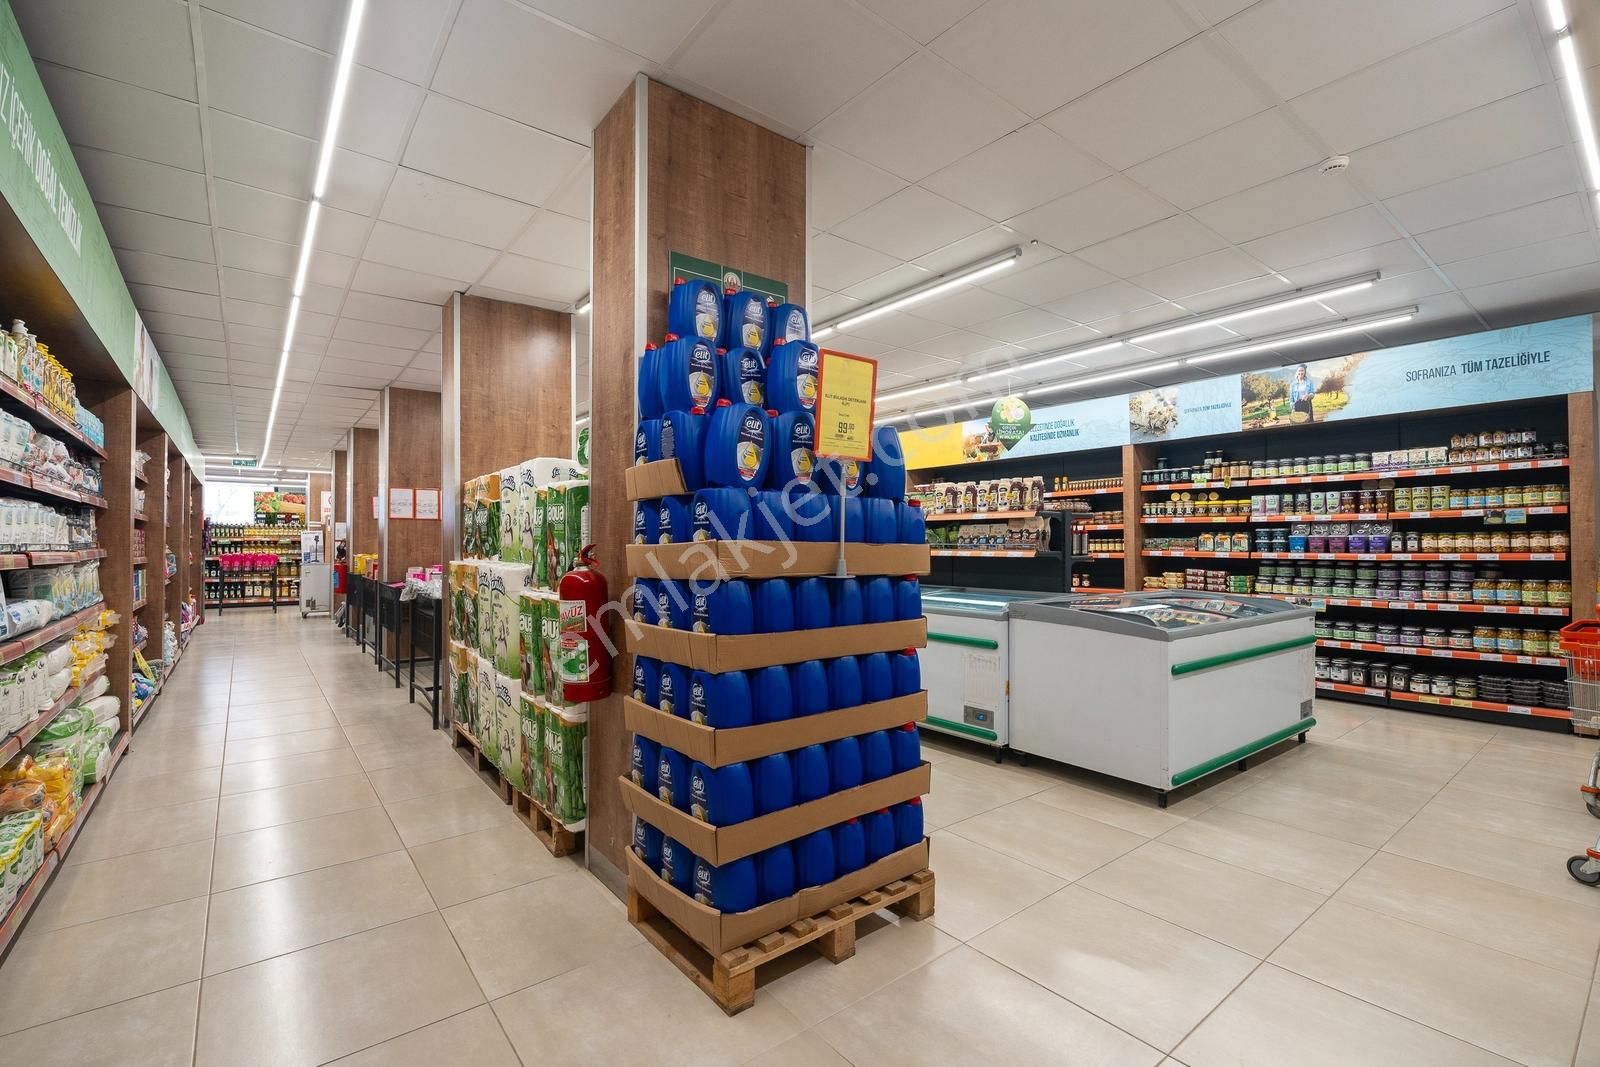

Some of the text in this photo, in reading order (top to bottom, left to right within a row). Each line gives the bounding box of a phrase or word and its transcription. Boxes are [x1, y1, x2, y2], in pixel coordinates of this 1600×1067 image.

[9, 75, 36, 174] İÇERİK
[35, 137, 57, 215] DOĞAL
[1405, 350, 1551, 383] SOFRANIZA TÜM TAZELİĞİYLE
[838, 421, 848, 434] 99
[548, 503, 564, 524] aqua
[560, 605, 584, 621] AVUZ
